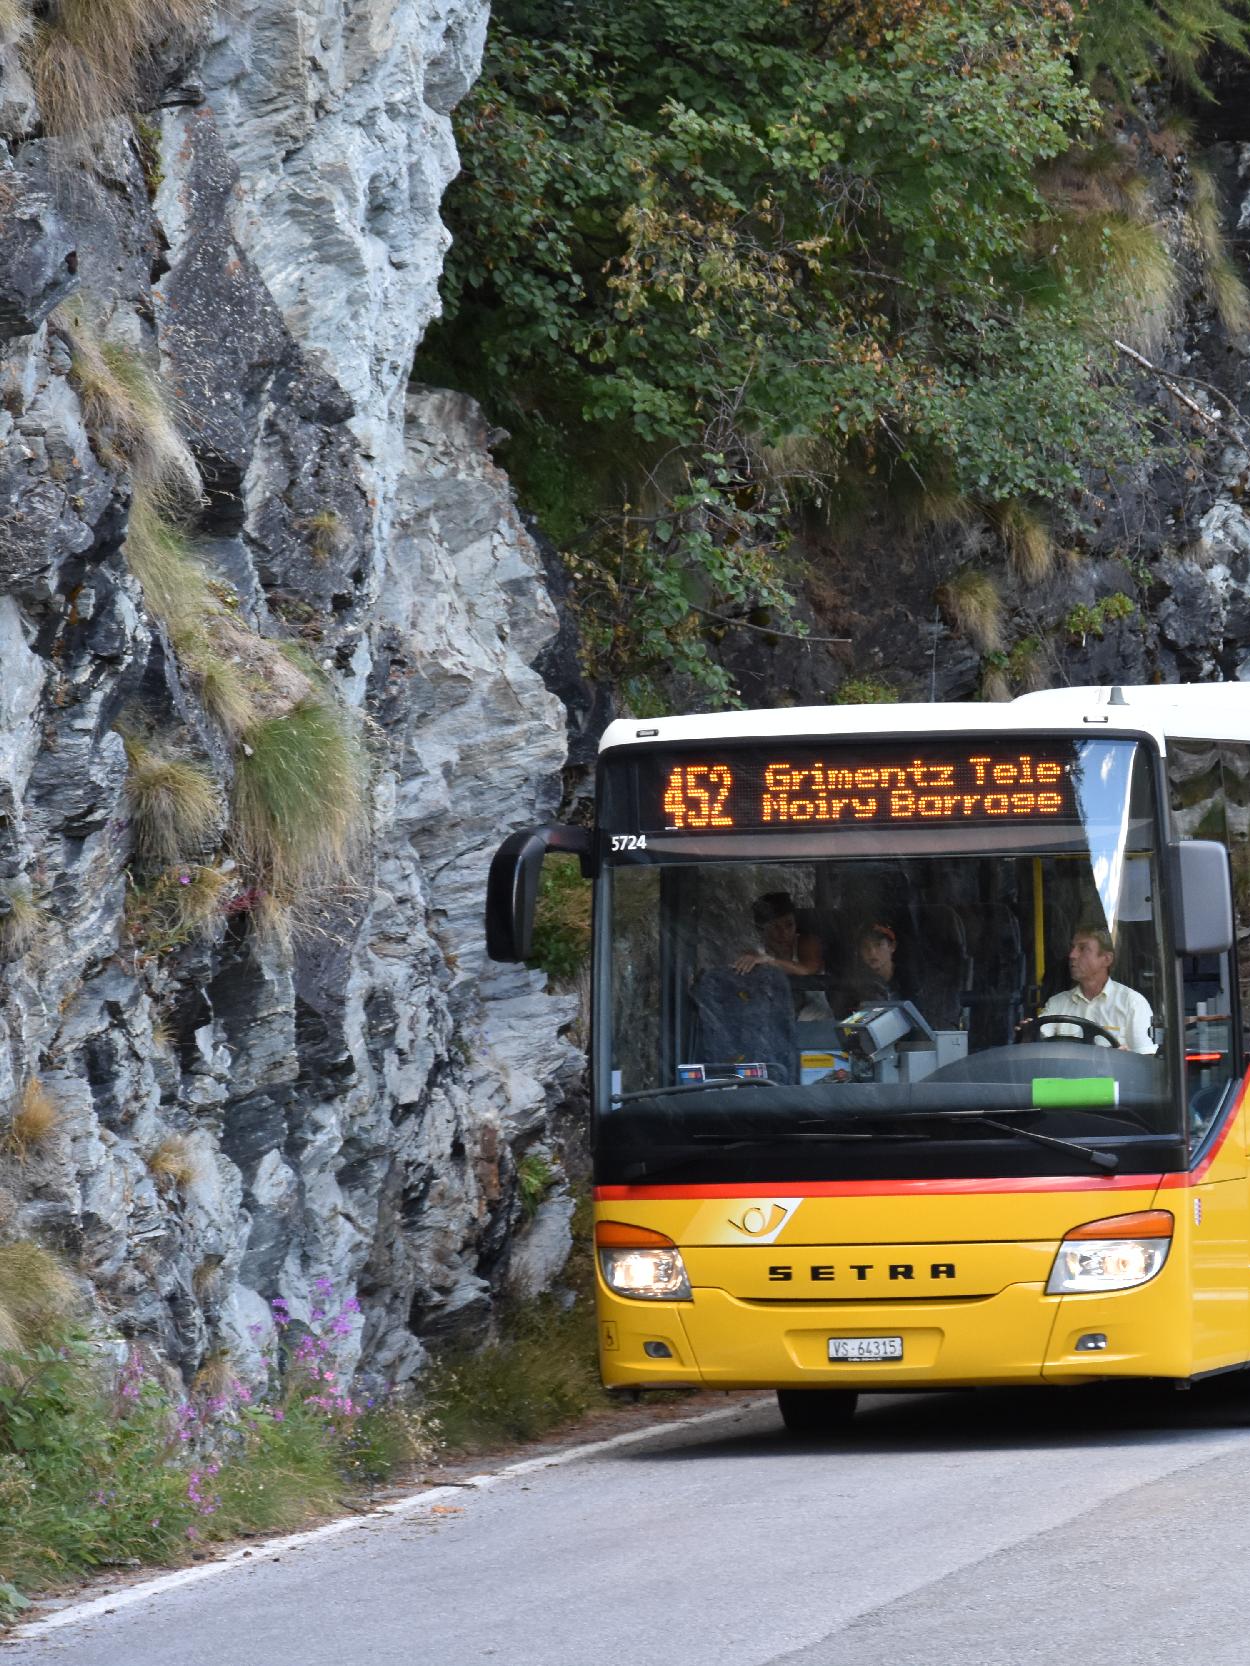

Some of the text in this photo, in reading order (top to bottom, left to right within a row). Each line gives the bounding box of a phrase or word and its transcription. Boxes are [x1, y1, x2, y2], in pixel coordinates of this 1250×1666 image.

[765, 755, 1061, 791] Grimentz Tele
[664, 765, 733, 827] 452
[762, 793, 877, 821] Moiry
[611, 834, 648, 851] 5724
[768, 1263, 956, 1282] SETRA
